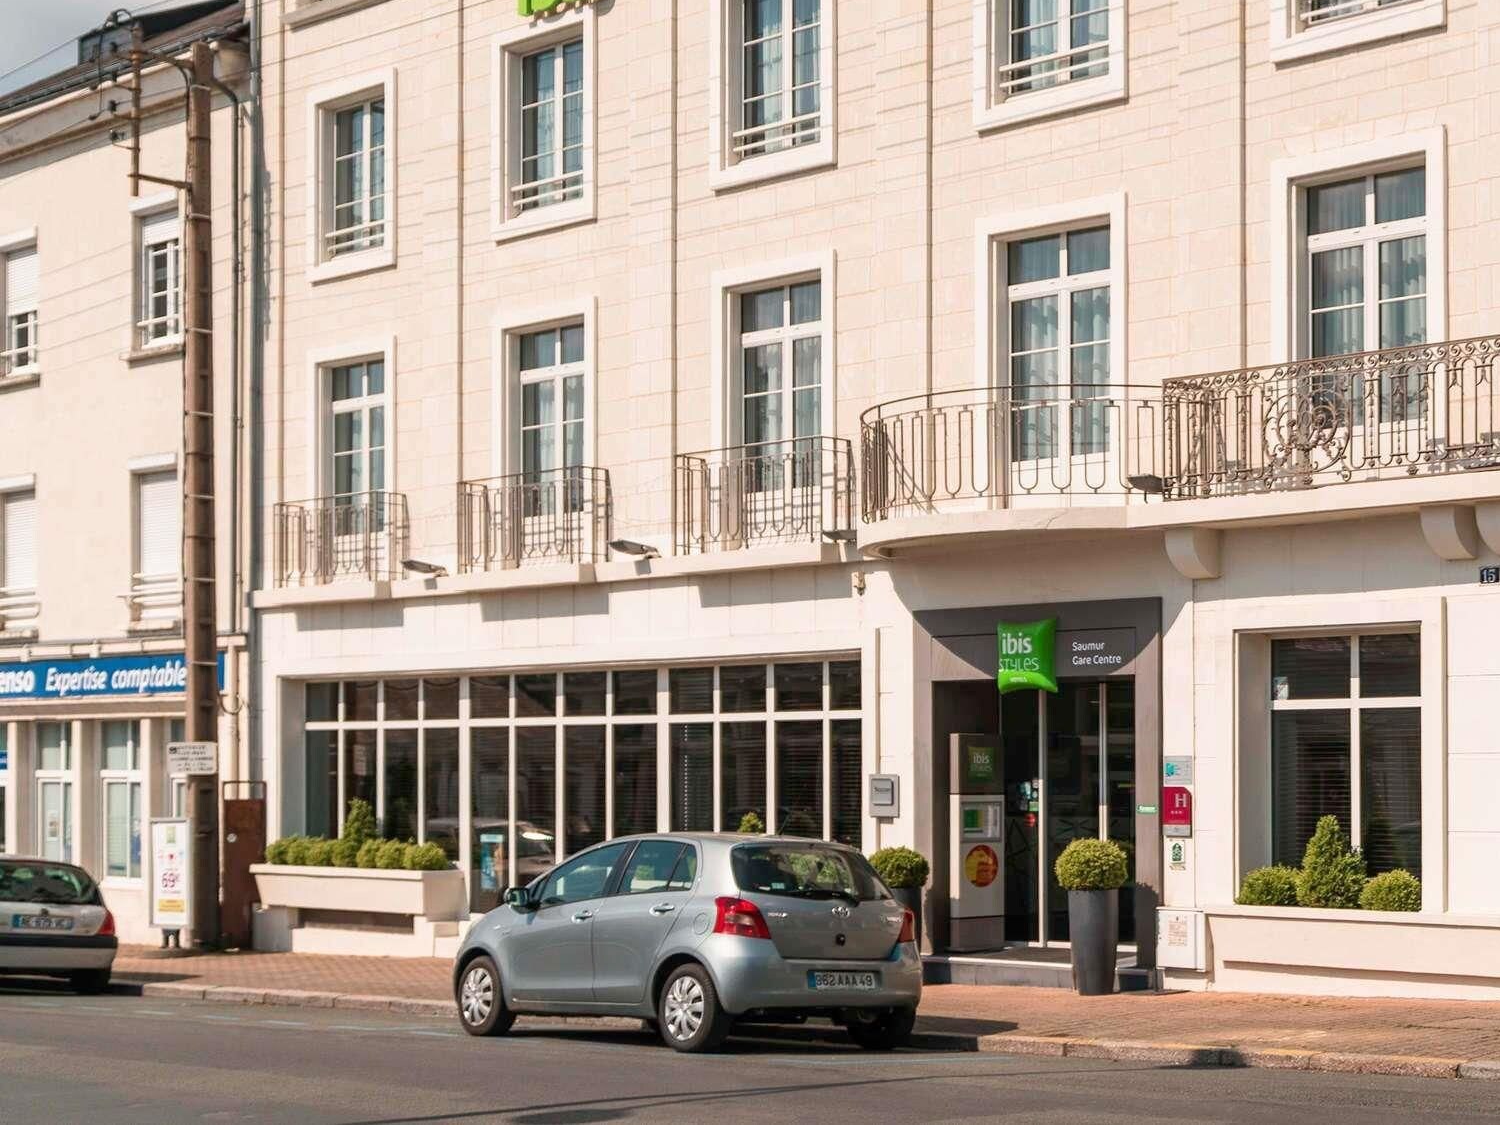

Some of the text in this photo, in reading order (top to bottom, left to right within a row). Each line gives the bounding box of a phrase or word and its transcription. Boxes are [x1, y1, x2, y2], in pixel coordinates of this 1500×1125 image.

[1482, 569, 1496, 582] 15
[1002, 633, 1032, 654] ibis
[1072, 641, 1105, 651] Saumur
[1072, 654, 1121, 665] Gare Centre
[45, 665, 107, 696] Expertise
[1175, 793, 1187, 808] H
